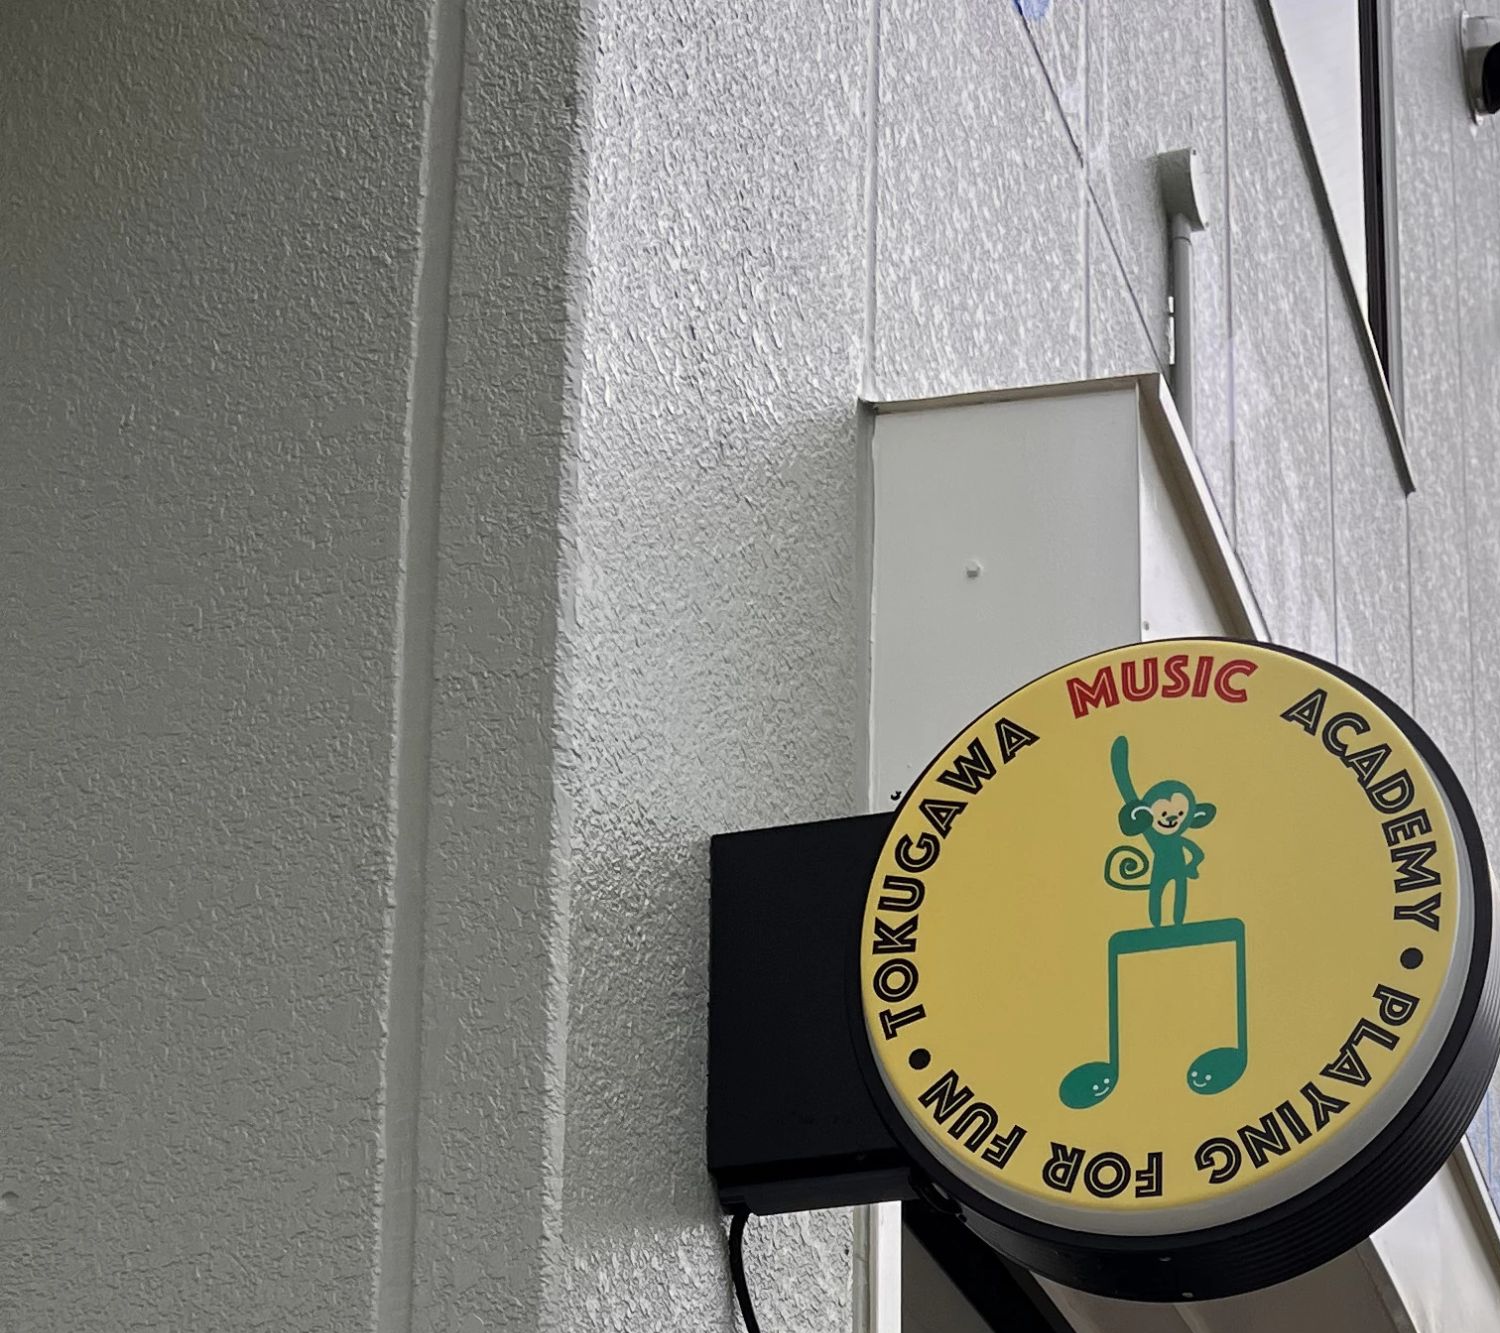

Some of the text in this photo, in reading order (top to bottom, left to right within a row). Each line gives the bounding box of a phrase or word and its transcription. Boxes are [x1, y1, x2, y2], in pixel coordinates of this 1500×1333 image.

[872, 654, 1442, 1040] TOKUGAWA MUSIC ACADEMY
[917, 983, 1420, 1198] PLAYING FOR FUN
